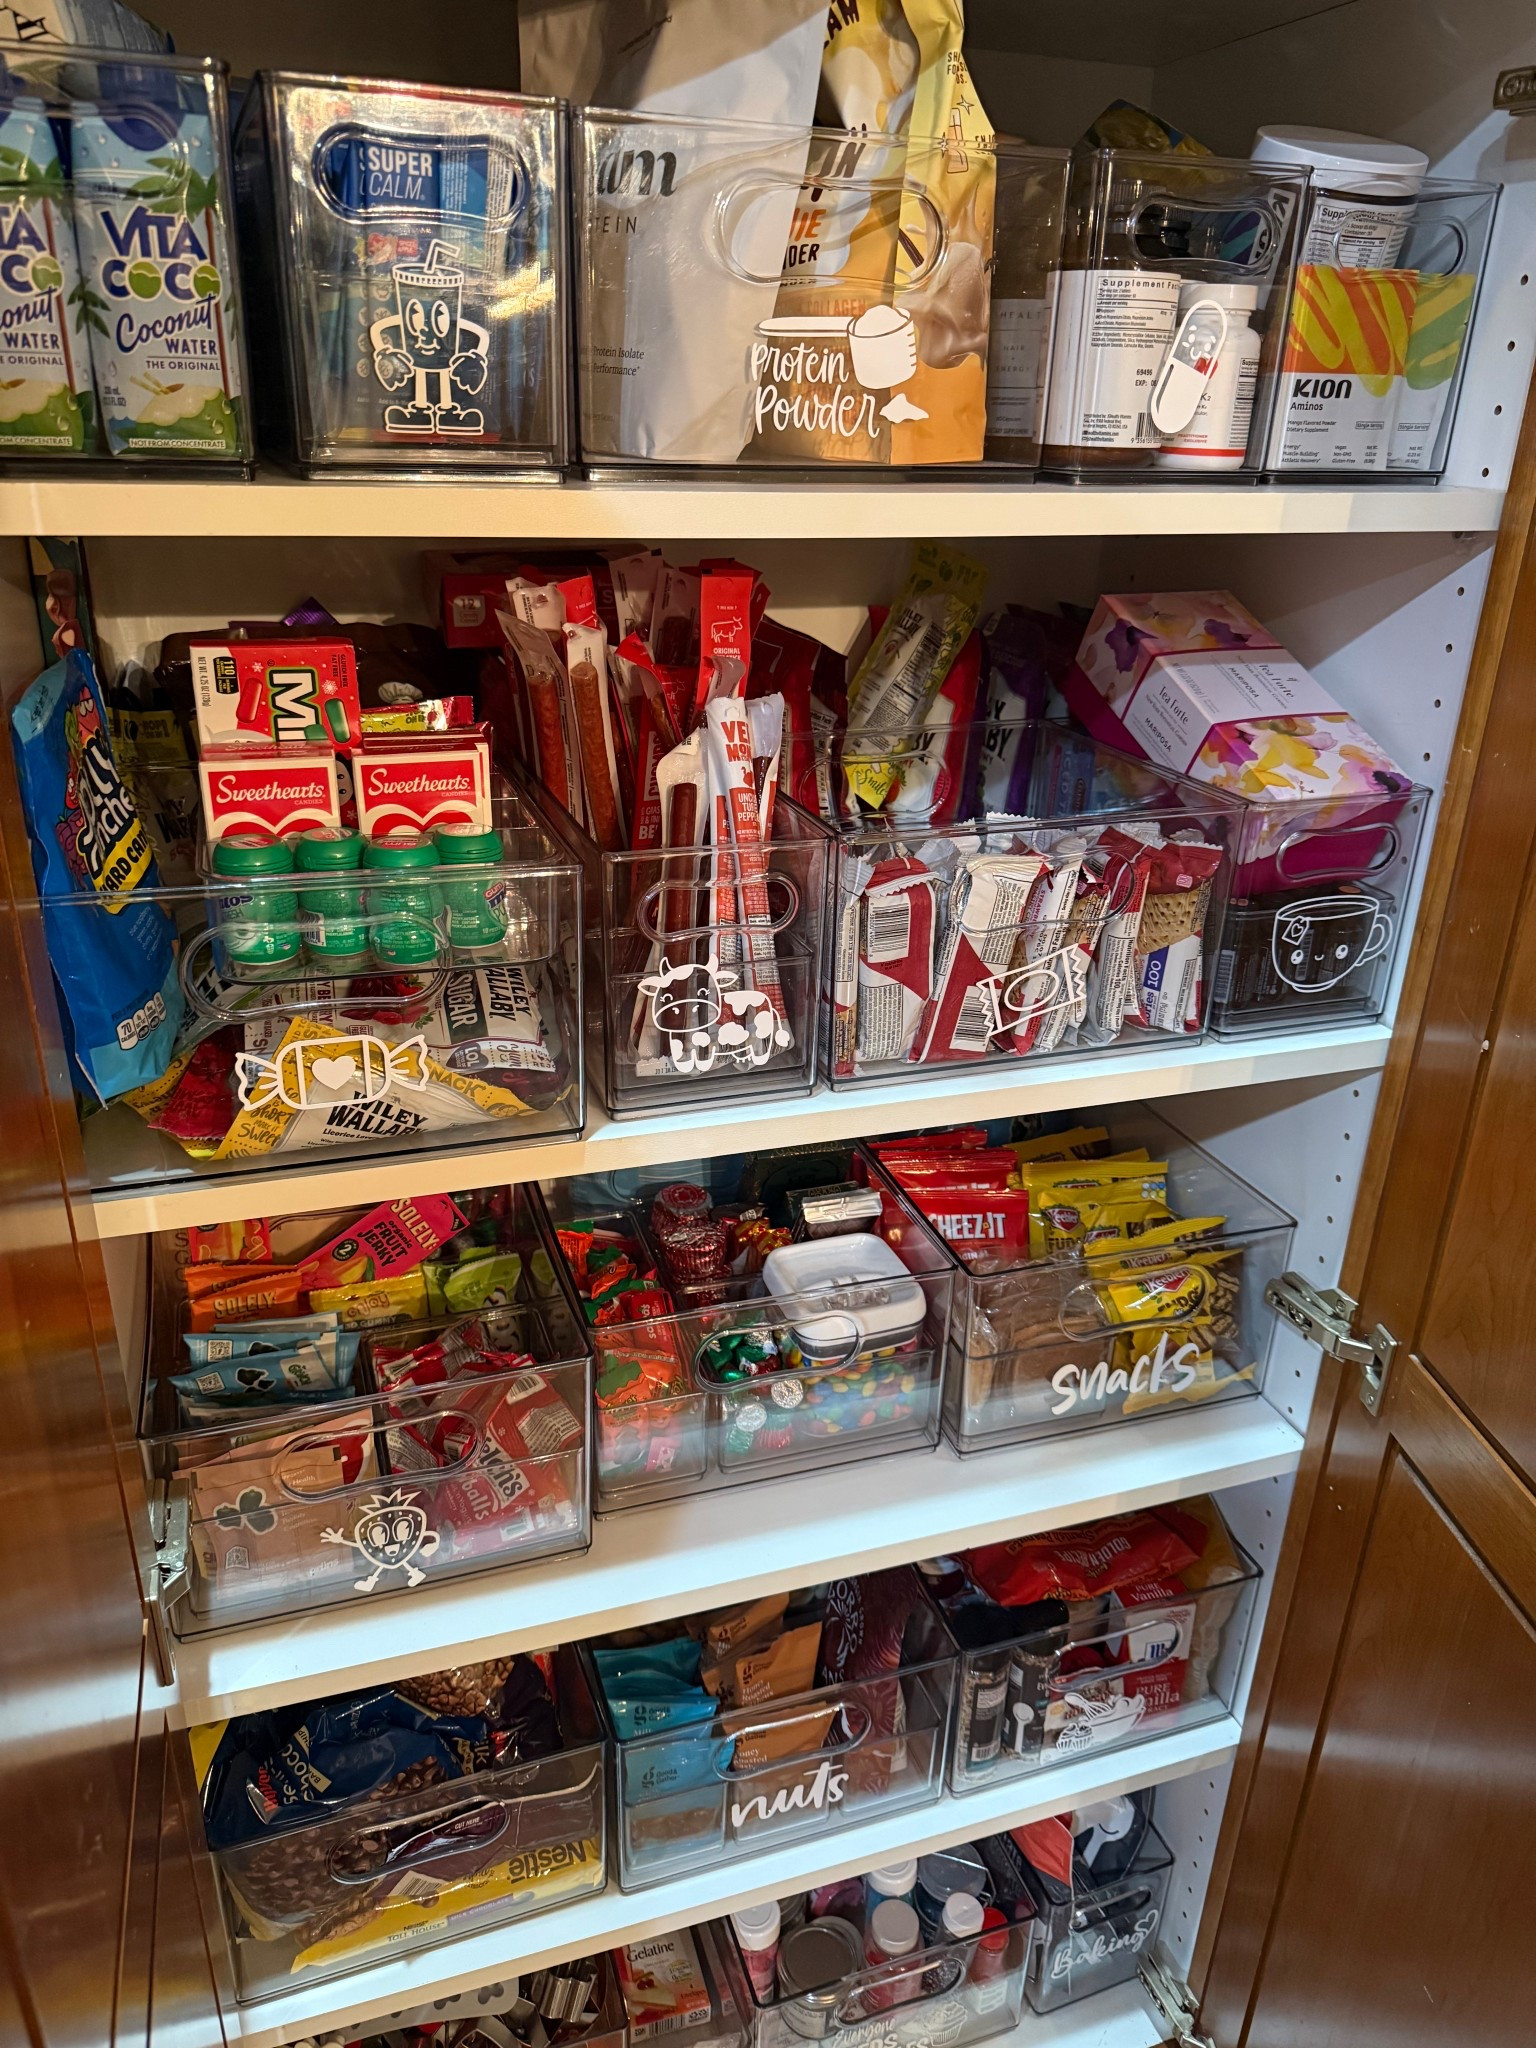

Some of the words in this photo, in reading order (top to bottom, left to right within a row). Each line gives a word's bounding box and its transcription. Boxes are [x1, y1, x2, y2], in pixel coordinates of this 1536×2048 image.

[368, 146, 433, 177] SUPER
[369, 172, 422, 200] CALM
[100, 204, 208, 261] VITA
[102, 258, 222, 301] COCO
[1102, 279, 1164, 289] Supplement
[116, 293, 216, 354] Coconut
[4, 332, 60, 350] WATER
[165, 338, 218, 356] WATER
[8, 356, 64, 366] ORIGINAL
[618, 347, 645, 360] Isolate
[750, 342, 850, 384] Protein
[146, 360, 166, 370] THE
[168, 360, 221, 371] ORIGINAL
[754, 384, 880, 439] Powder
[1290, 401, 1324, 411] Aminos
[15, 437, 72, 446] CONCENTRATE
[130, 439, 148, 447] NOT
[149, 440, 170, 448] FROM
[170, 440, 226, 449] CONCENTRATE
[713, 647, 741, 655] ORIGINAL
[225, 659, 236, 676] 110
[1228, 667, 1260, 699] MARIPOSA
[1144, 717, 1172, 752] MARIPOSA
[216, 774, 325, 804] Sweethearts
[368, 767, 471, 796] Sweethearts
[294, 798, 323, 806] CANDIES
[441, 790, 469, 798] CANDIES
[1147, 960, 1162, 988] 100
[449, 972, 478, 1030] SUGAR
[505, 967, 532, 1017] WILEY
[121, 1022, 132, 1036] 70
[464, 1046, 480, 1068] LOL
[352, 1090, 428, 1128] WILEY
[322, 1128, 355, 1140] Licorice
[387, 1220, 413, 1249] organic
[389, 1197, 440, 1250] SOLELY
[343, 1243, 352, 1255] 2
[357, 1228, 397, 1267] JERKY
[374, 1221, 408, 1258] FRUIT
[1127, 1253, 1170, 1269] Keebler
[1148, 1268, 1189, 1293] Keebler
[213, 1291, 277, 1319] SOLELY
[359, 1315, 397, 1329] GUMMY
[1131, 1588, 1174, 1602] Vanilla
[742, 1679, 764, 1695] Honey
[1136, 1682, 1171, 1695] PURE
[731, 1761, 850, 1828] nuts
[451, 1911, 467, 1921] MILK
[468, 1897, 510, 1916] CHOCOLATE
[387, 1932, 410, 1943] TOLL
[411, 1922, 446, 1937] HOUSE
[626, 1942, 676, 1962] Gelatine
[832, 2018, 896, 2047] Everyone
